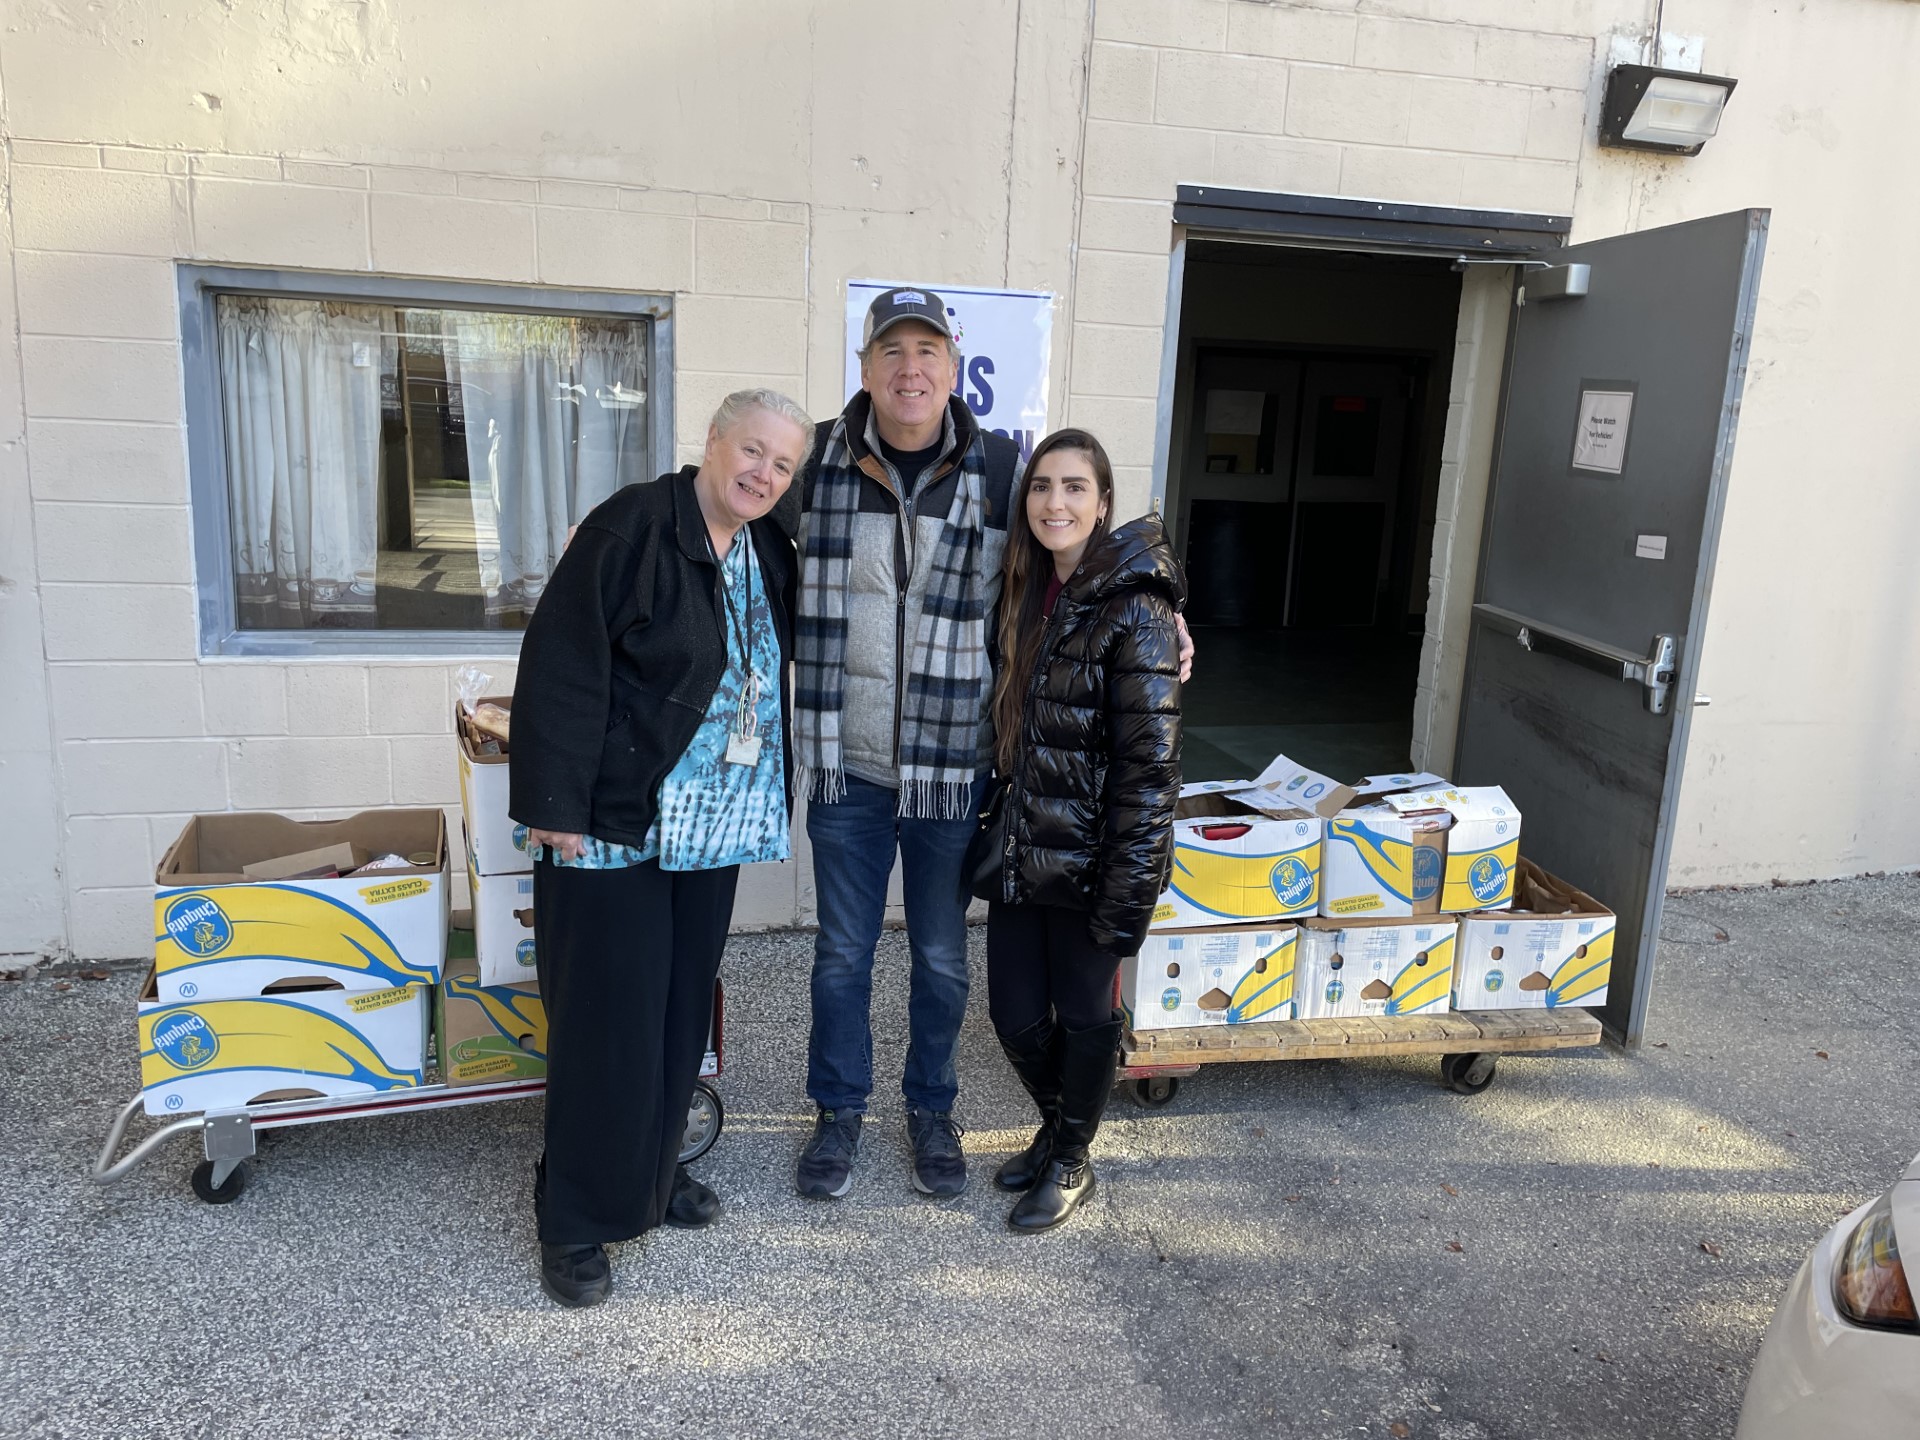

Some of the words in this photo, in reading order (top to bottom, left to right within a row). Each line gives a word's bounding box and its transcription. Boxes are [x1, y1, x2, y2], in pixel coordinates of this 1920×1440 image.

[397, 880, 422, 892] CLASS
[1413, 875, 1439, 891] iquita
[1473, 872, 1507, 899] Chiquita
[369, 886, 396, 897] EXTRA
[397, 887, 427, 898] SELECTED
[1277, 875, 1313, 904] Chiquita
[370, 894, 396, 903] QUALITY
[1336, 904, 1357, 913] CLASS
[1357, 901, 1378, 910] EXTRA
[167, 900, 219, 933] Chiquita
[382, 988, 407, 998] CLASS
[354, 994, 381, 1005] EXTRA
[356, 1001, 381, 1011] QUALITY
[153, 1015, 205, 1048] Chiquita
[487, 1063, 511, 1072] QUALITY
